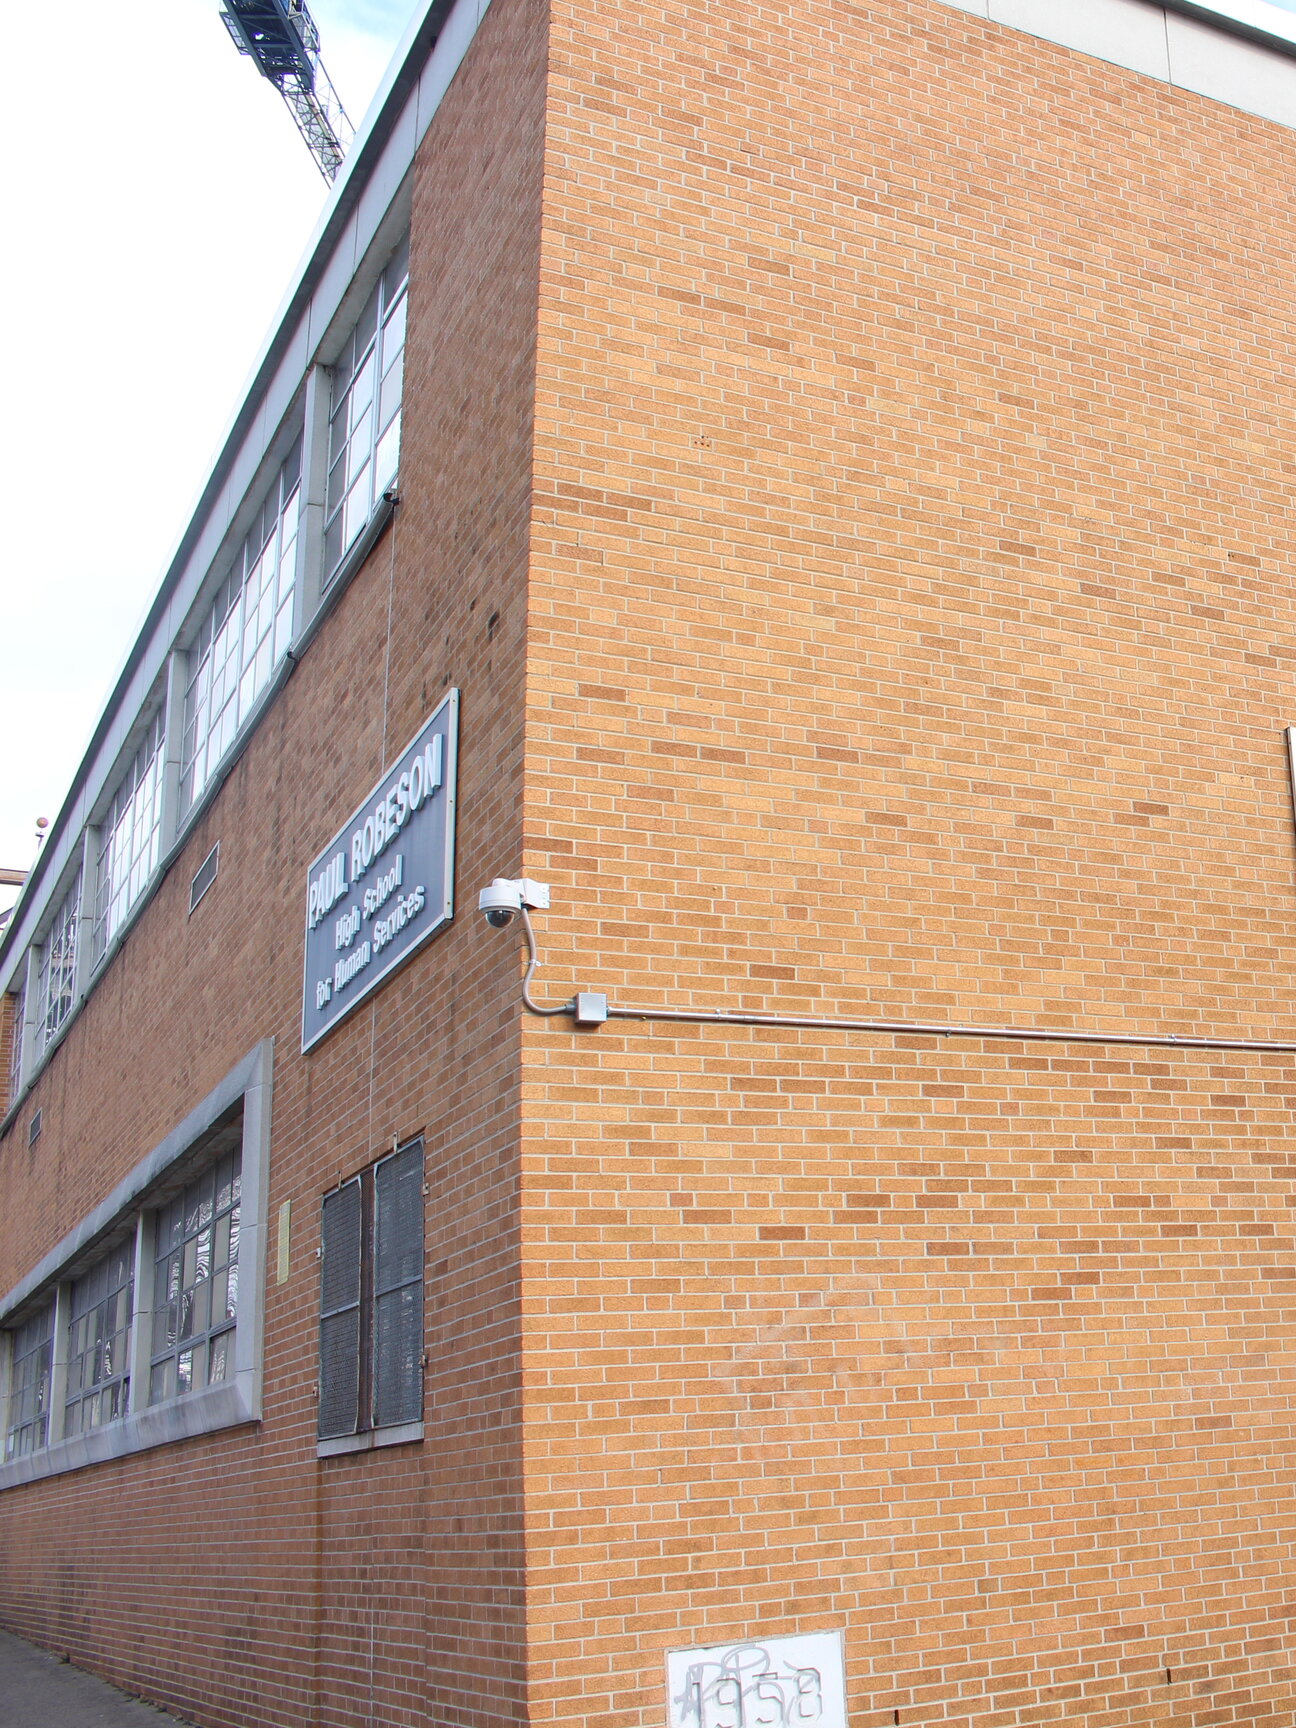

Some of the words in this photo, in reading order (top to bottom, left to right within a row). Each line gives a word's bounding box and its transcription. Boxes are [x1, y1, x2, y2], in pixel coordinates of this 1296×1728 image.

[308, 852, 349, 929] PAUL
[351, 733, 443, 882] ROBESON
[316, 976, 333, 1010] for
[334, 940, 370, 992] Human
[373, 885, 425, 953] Services
[335, 905, 360, 950] High
[362, 854, 403, 920] School
[692, 1667, 823, 1728] 1958
